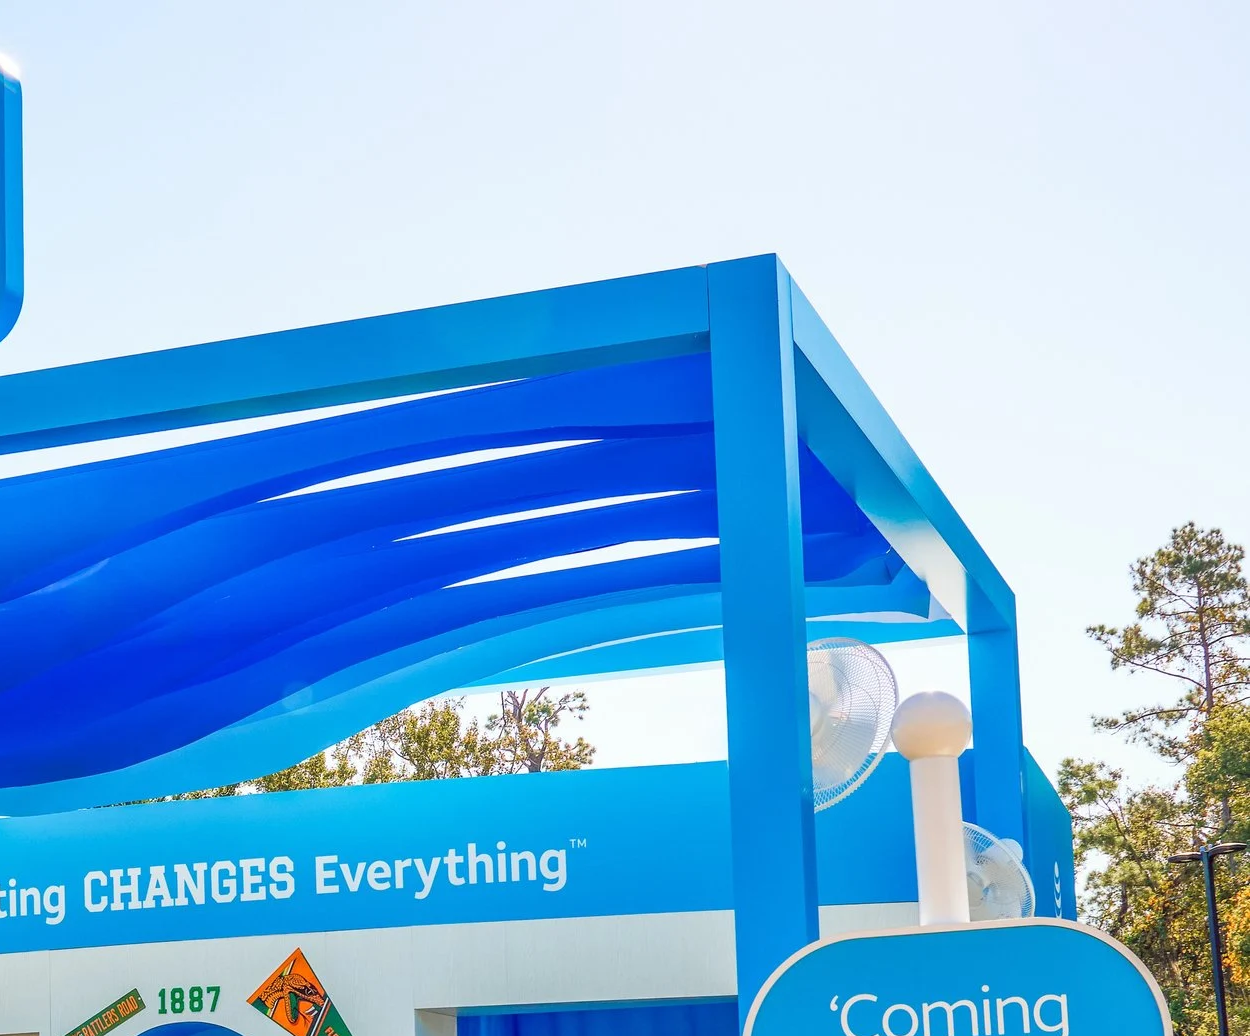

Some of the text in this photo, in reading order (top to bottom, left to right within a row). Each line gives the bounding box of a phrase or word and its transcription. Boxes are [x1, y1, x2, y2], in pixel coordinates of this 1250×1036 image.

[83, 855, 296, 913] CHANGES
[116, 995, 139, 1018] ROAD
[158, 986, 221, 1015] 1887
